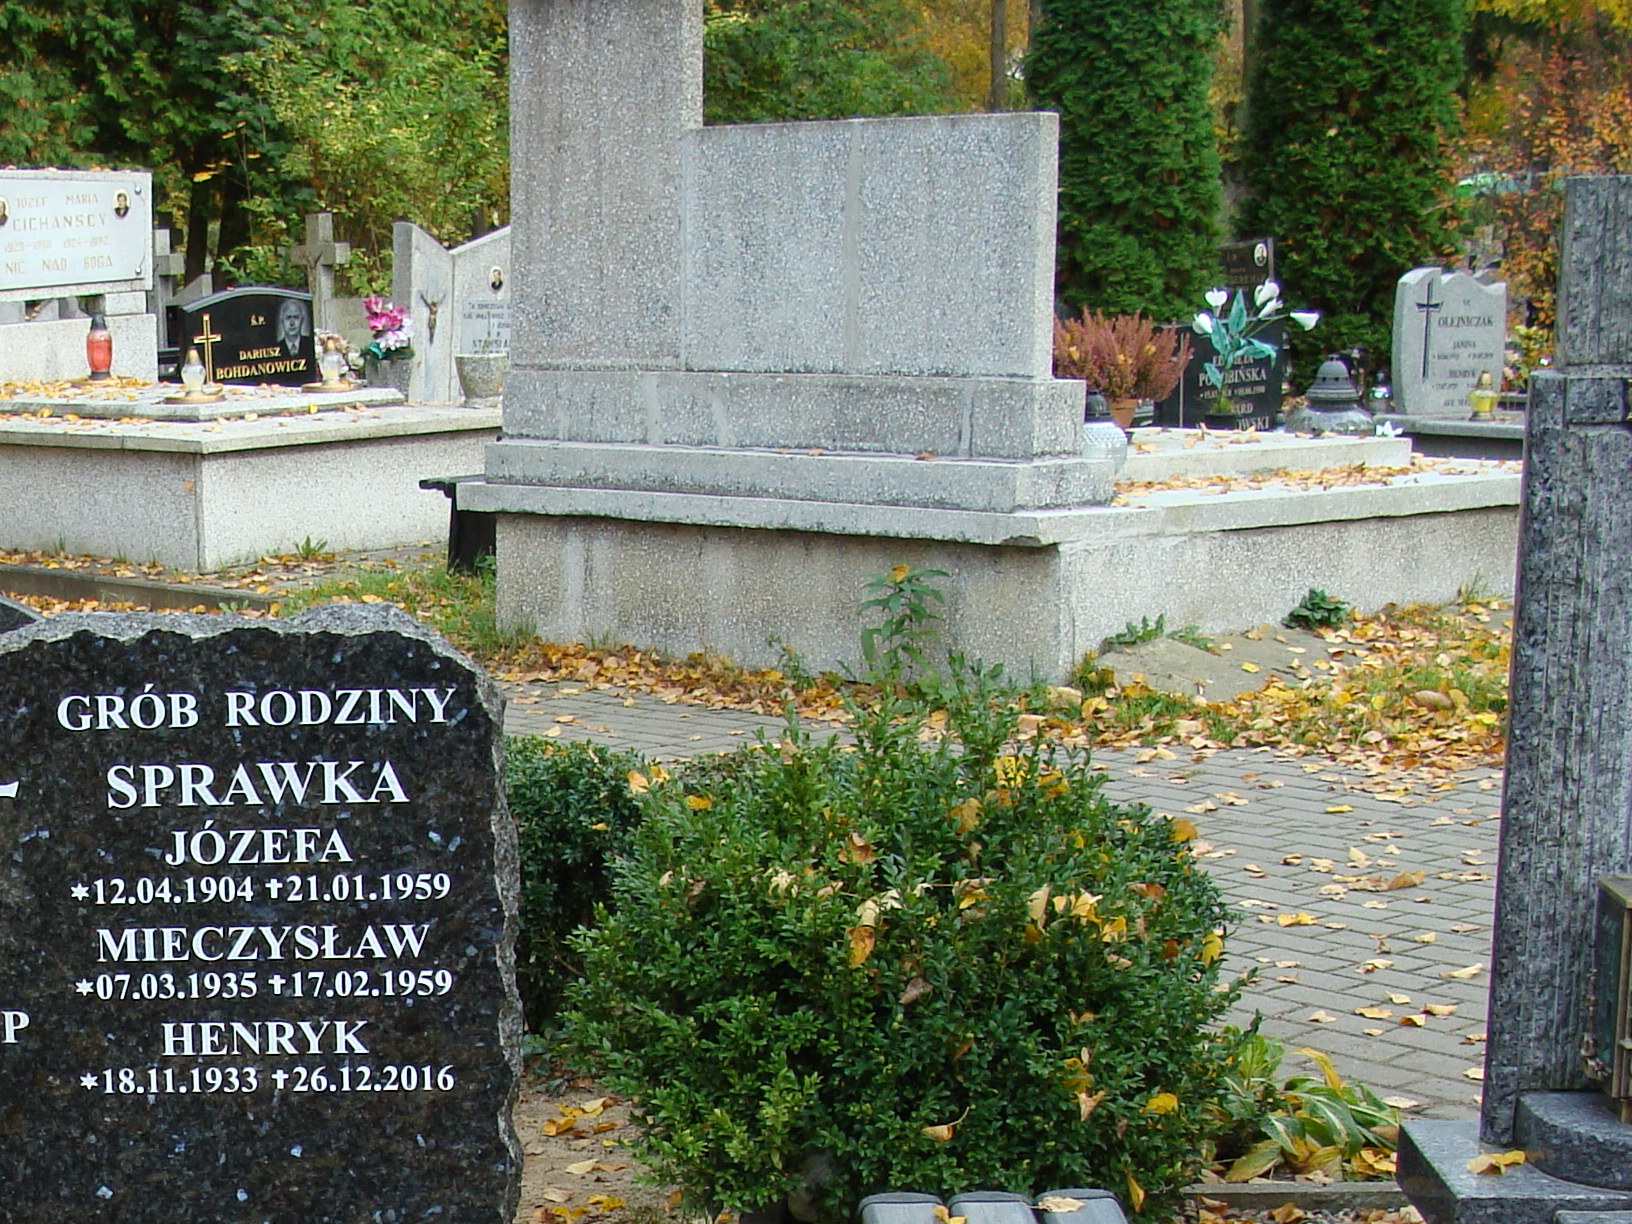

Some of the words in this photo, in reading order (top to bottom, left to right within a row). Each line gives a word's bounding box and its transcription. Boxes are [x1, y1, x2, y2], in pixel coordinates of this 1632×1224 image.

[216, 359, 307, 379] BOHDANOWICZ
[239, 346, 281, 360] DARIUSZ
[58, 683, 199, 731] GRÓB
[225, 687, 456, 727] RODZINY
[106, 760, 410, 810] SPRAWKA
[165, 819, 353, 866] JÓZEFA
[94, 876, 254, 905] 12.04.1904
[287, 873, 451, 902] 21.01.1959
[96, 924, 430, 962] MIECZYSŁAW
[97, 972, 257, 1000] 07.03.1935
[292, 969, 453, 998] 17.02.1959
[2, 1011, 30, 1043] P
[162, 1020, 370, 1056] HENRYK
[103, 1066, 258, 1094] 18.11.1933
[292, 1064, 455, 1092] 26.12.2016
